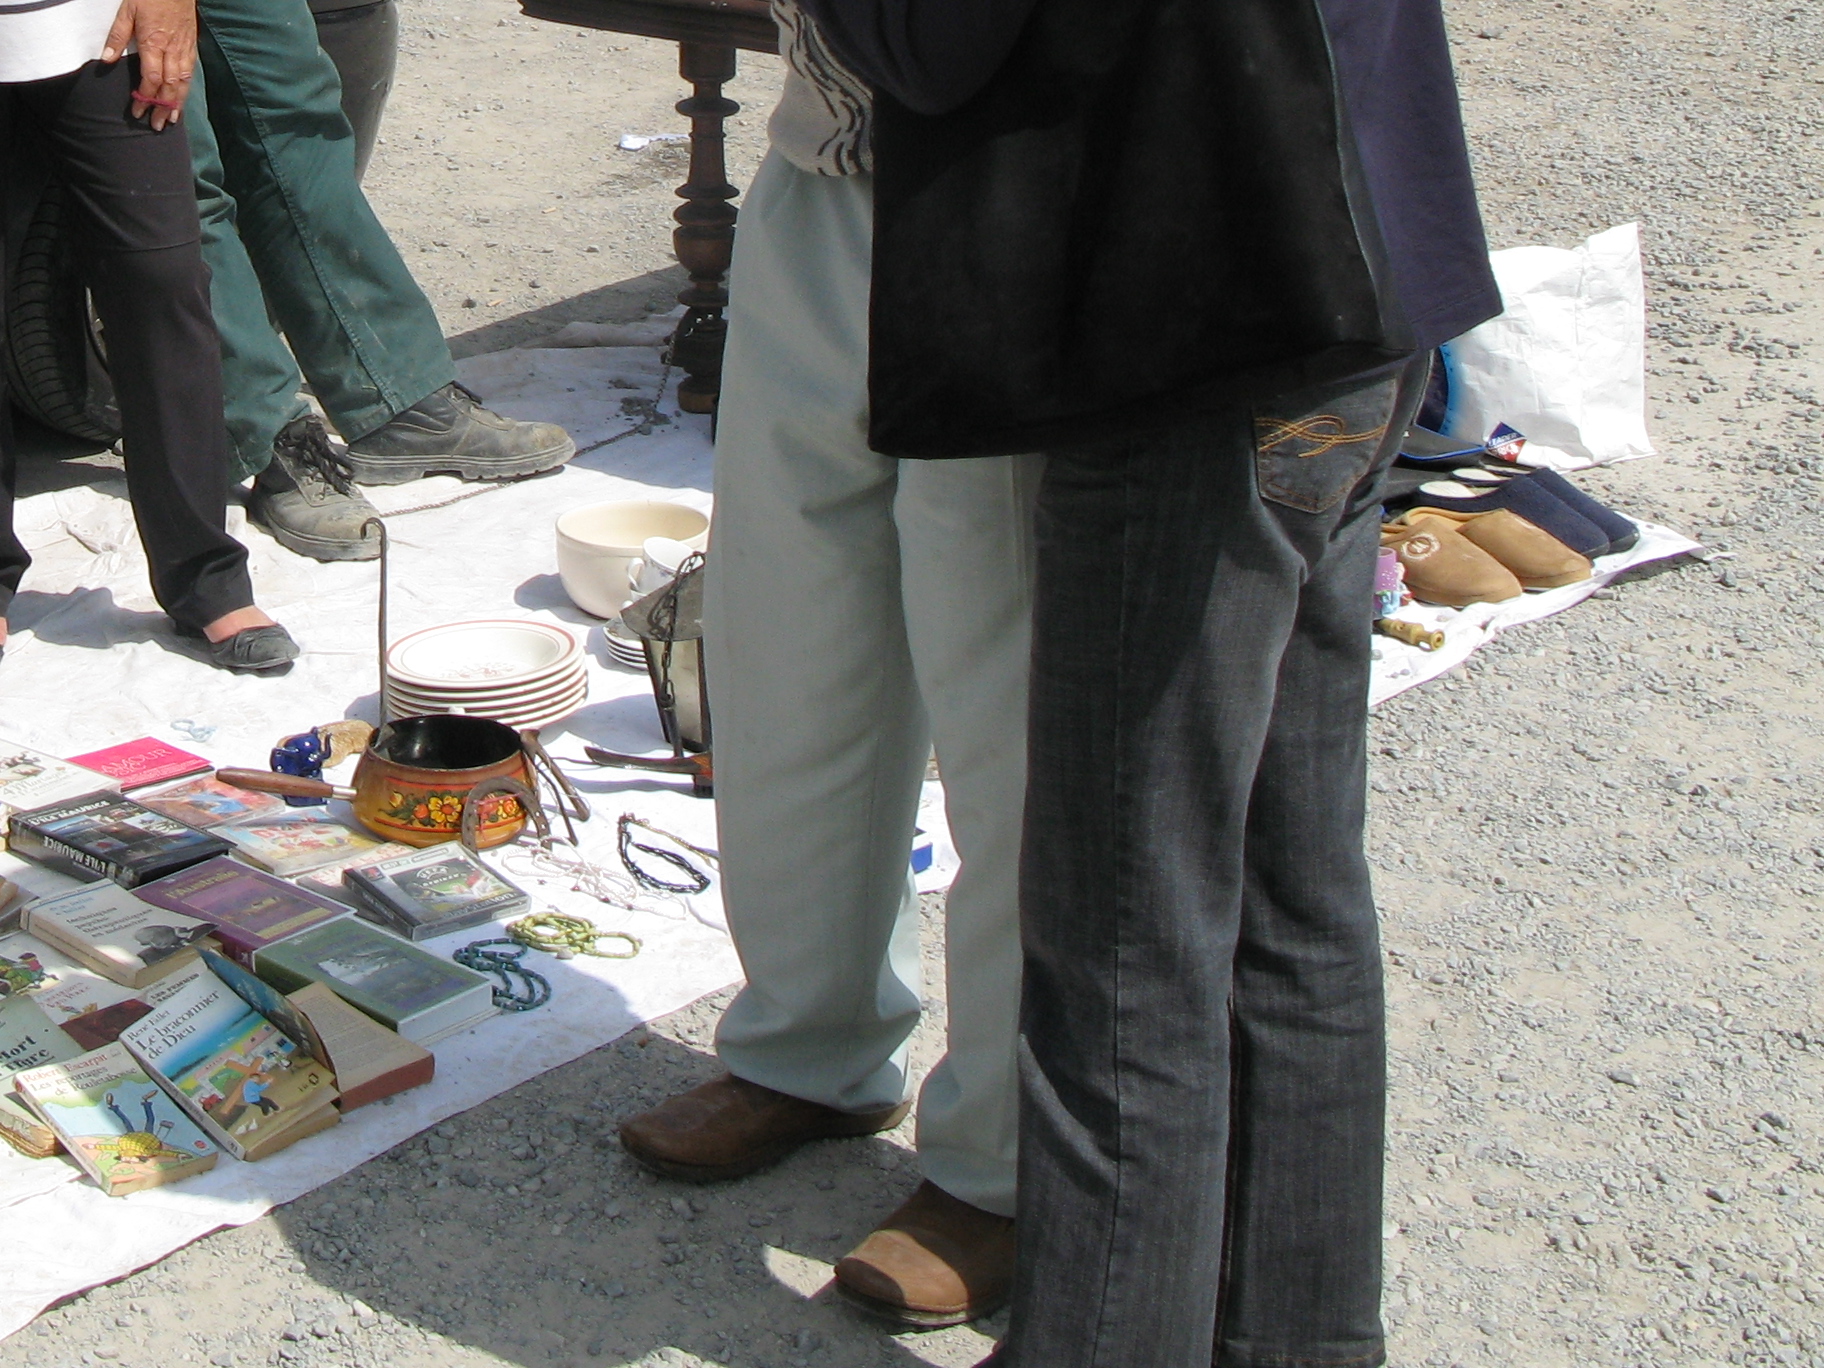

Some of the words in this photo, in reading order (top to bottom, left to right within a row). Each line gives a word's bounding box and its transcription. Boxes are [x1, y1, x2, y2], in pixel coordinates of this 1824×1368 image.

[43, 835, 85, 864] MAURICE
[135, 1036, 157, 1052] Le
[157, 989, 220, 1038] braconnier
[147, 1046, 164, 1060] de
[163, 1024, 197, 1050] Dieu
[23, 1064, 61, 1084] Robert
[64, 1052, 108, 1073] Escarpit
[31, 1079, 52, 1092] Les
[53, 1065, 109, 1088] reportages
[54, 1083, 69, 1096] de
